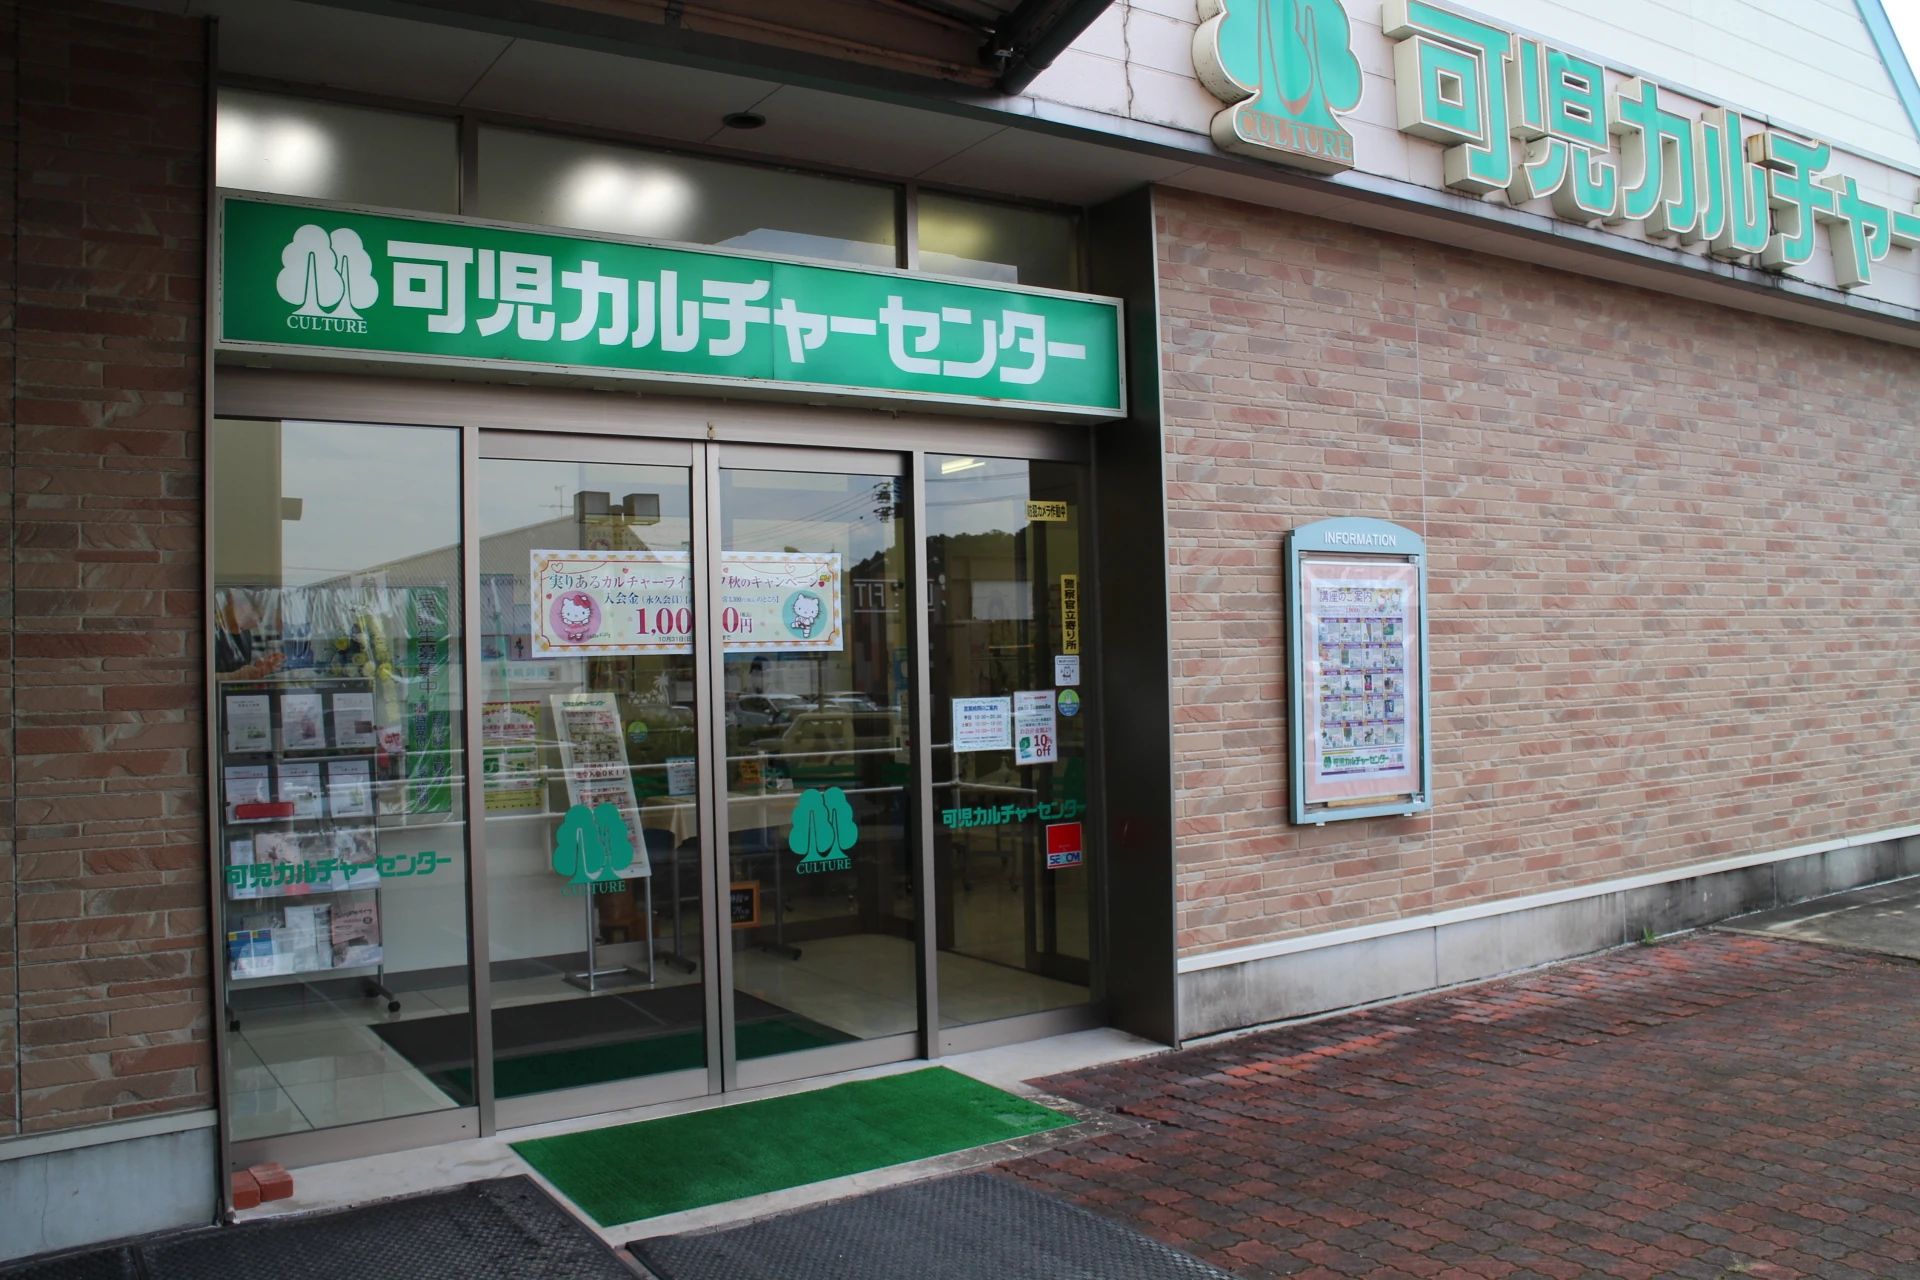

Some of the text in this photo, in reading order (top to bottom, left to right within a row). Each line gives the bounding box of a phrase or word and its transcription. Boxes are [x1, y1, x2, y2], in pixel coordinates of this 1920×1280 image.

[1237, 110, 1353, 161] CULTURE
[286, 314, 369, 334] CULTURE
[386, 239, 1087, 386] 可児カルチャーセンター
[1324, 531, 1396, 546] INFORMATION
[942, 799, 1086, 828] 可児カルチャーセンター
[225, 851, 452, 889] 可児カルチャーセンター
[796, 859, 852, 875] CULTURE
[1049, 852, 1081, 865] SEOM
